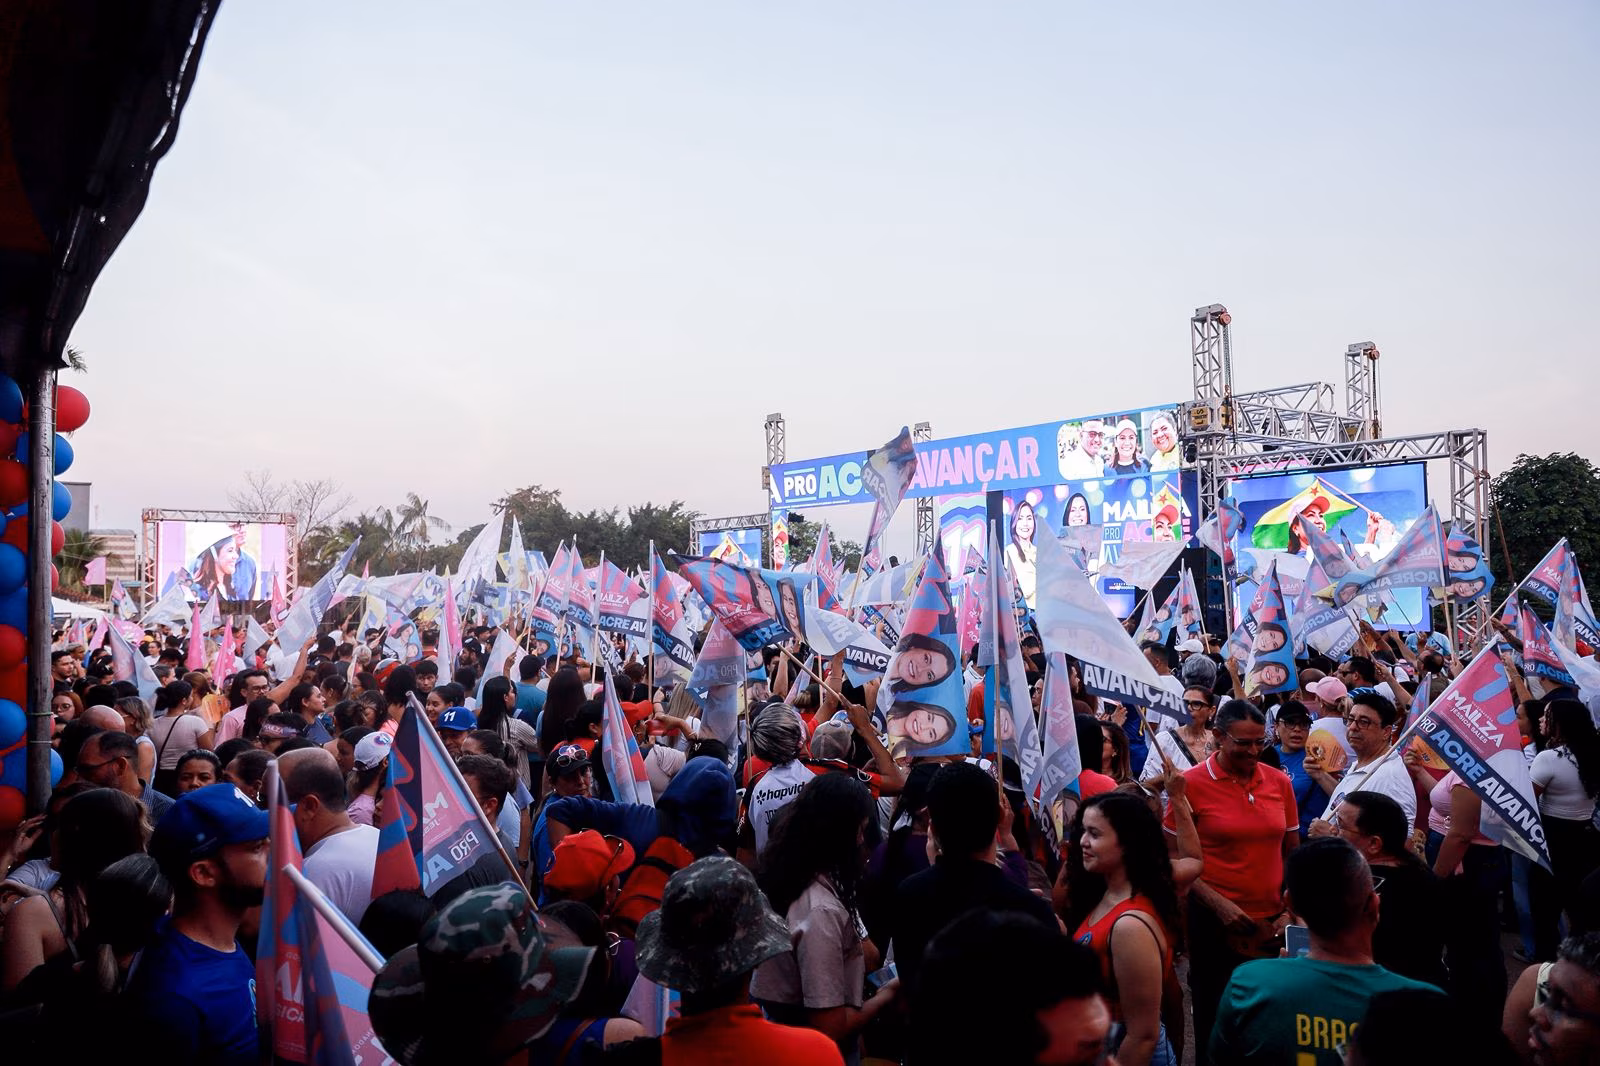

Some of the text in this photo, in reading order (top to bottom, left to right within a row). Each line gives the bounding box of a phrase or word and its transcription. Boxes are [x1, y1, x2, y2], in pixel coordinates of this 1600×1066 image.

[783, 474, 817, 498] PRO
[907, 436, 1041, 495] AVANÇAR
[1104, 527, 1120, 540] PRO
[1526, 579, 1540, 590] PRO
[599, 615, 630, 630] ACRE
[1523, 660, 1576, 685] PRO ACRE
[1083, 663, 1188, 715] AVANÇAR
[442, 710, 456, 722] 11
[1446, 689, 1505, 749] MAILZA
[1450, 707, 1472, 729] JESSICA
[1470, 725, 1489, 744] SALES
[1430, 729, 1487, 782] ACRE
